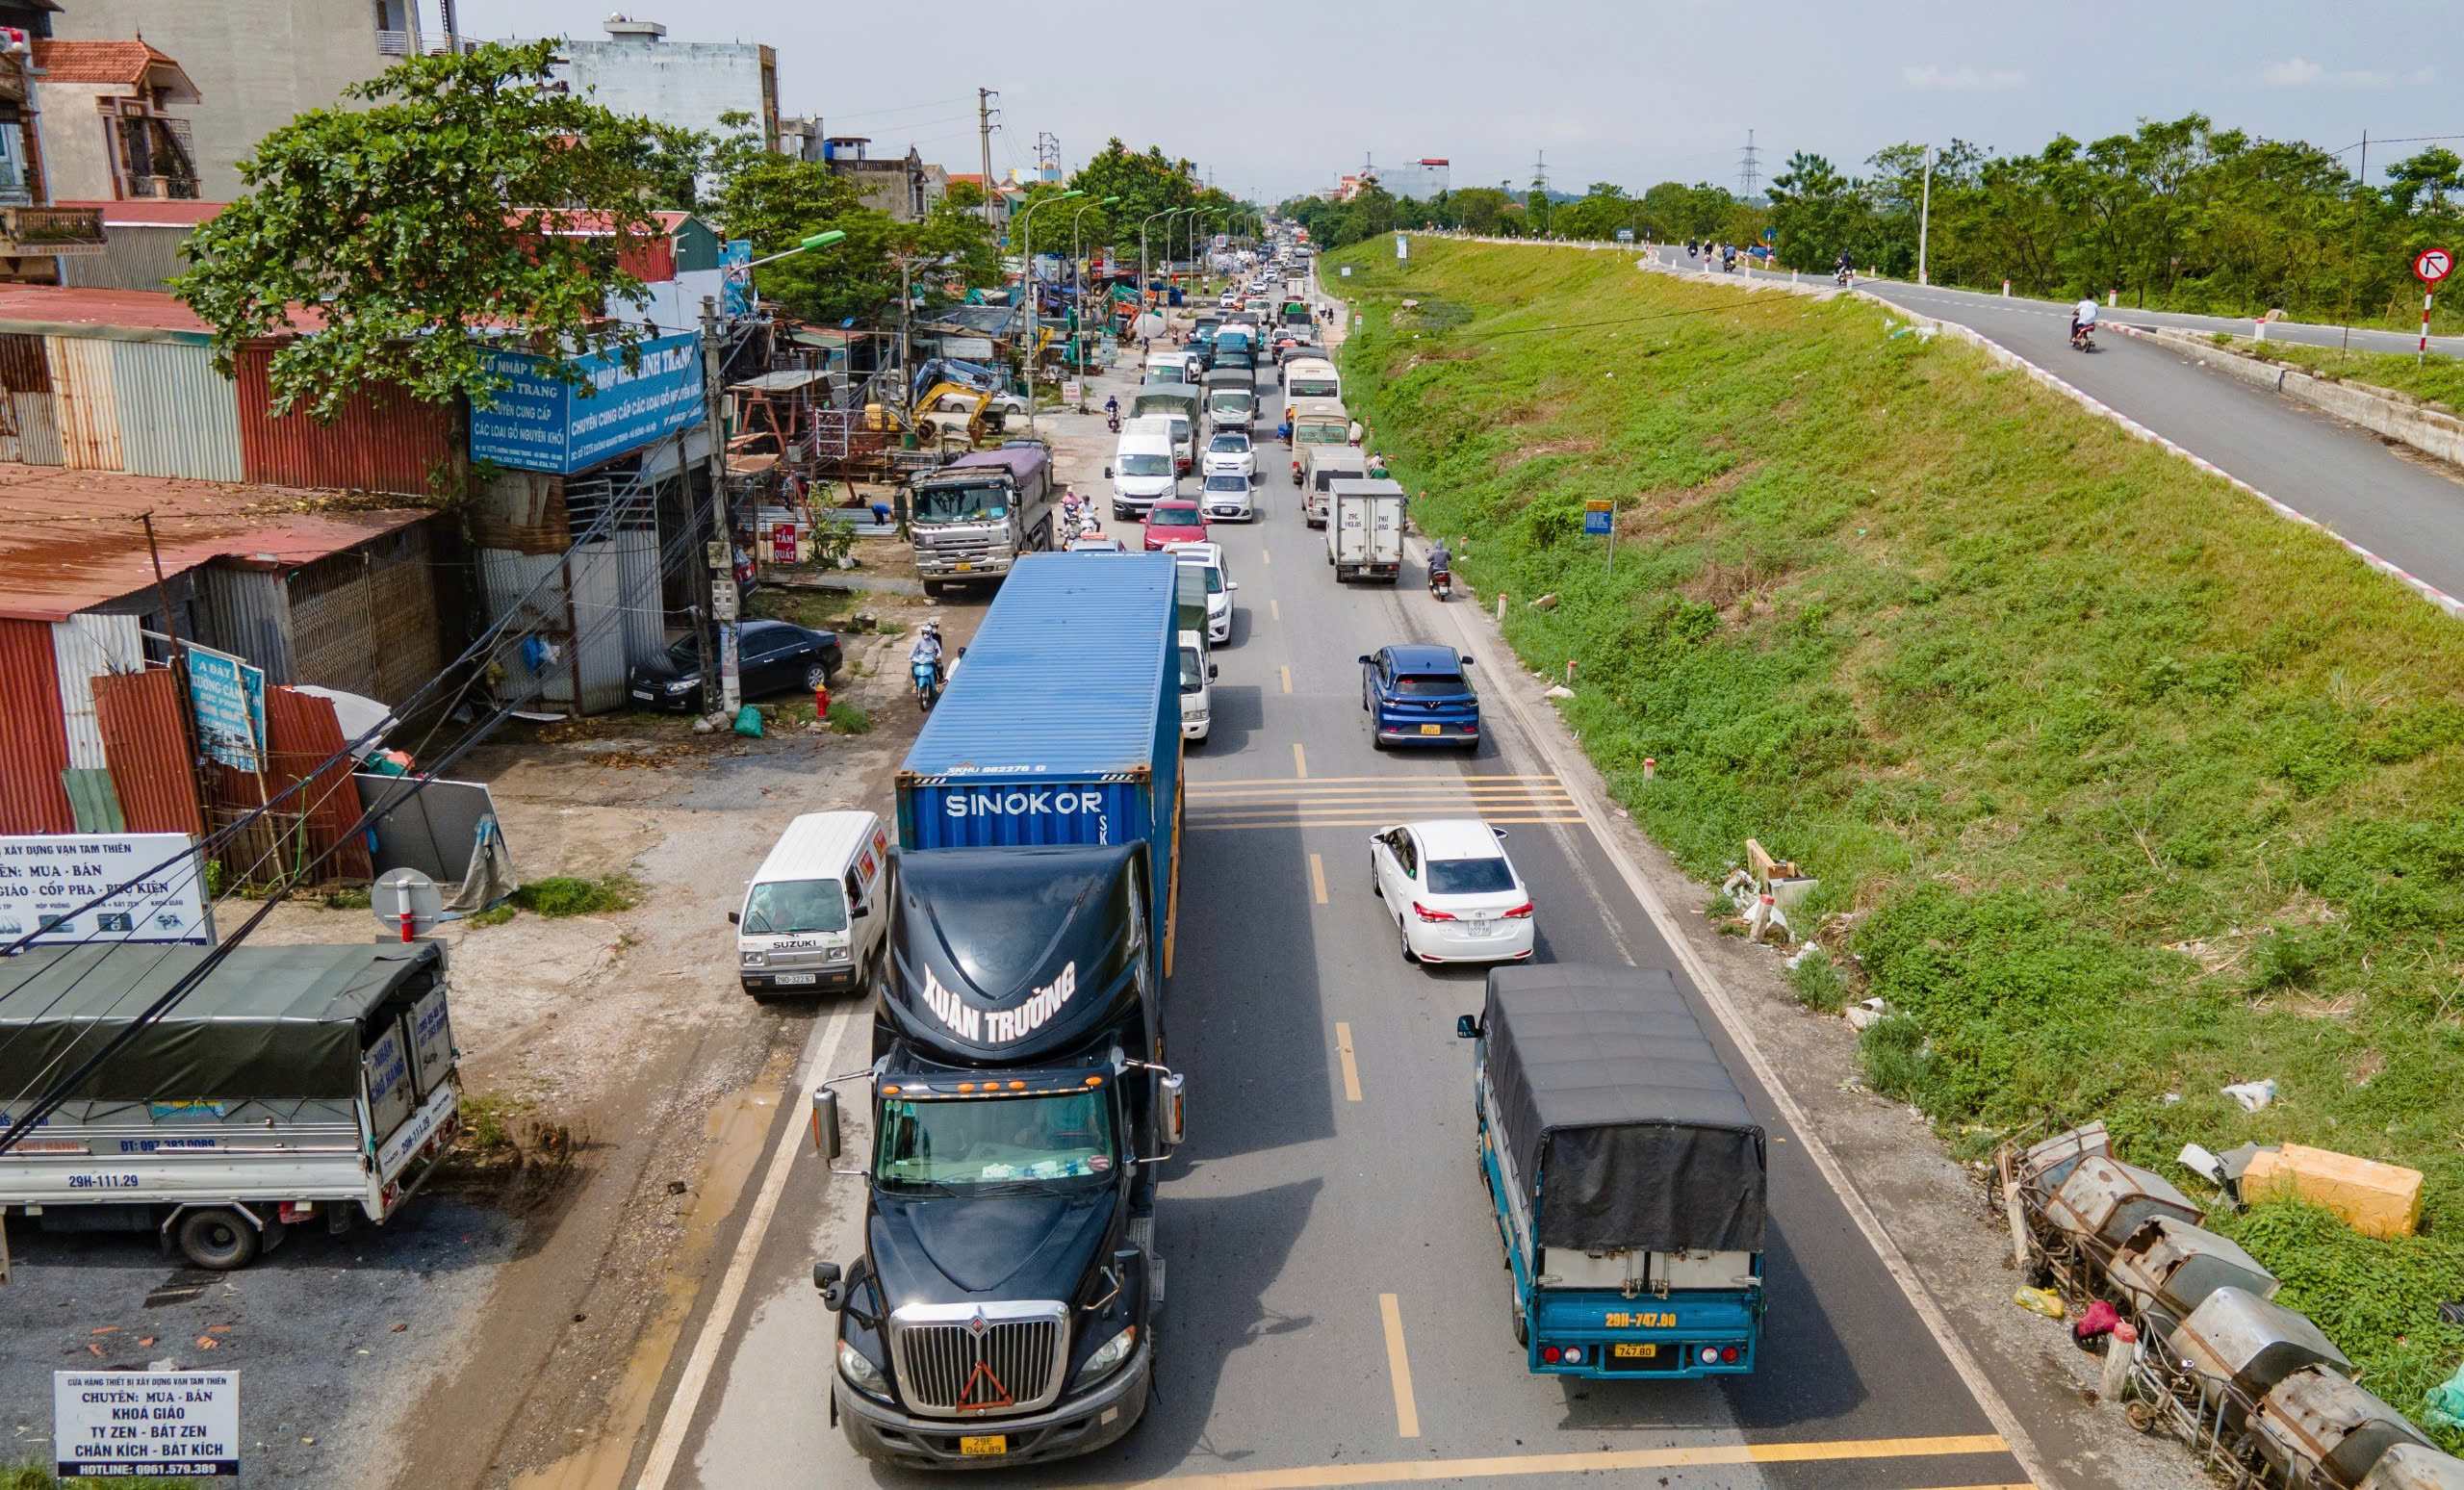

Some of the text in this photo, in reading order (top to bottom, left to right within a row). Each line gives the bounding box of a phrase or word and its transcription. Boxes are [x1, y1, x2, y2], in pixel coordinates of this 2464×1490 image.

[498, 360, 528, 376] NHẬP
[516, 382, 558, 398] TRANG
[516, 404, 536, 420] CUNG
[537, 403, 552, 421] CẤP
[571, 412, 598, 436] CHUYÊN
[599, 407, 617, 426] CUNG
[618, 398, 631, 420] CẤP
[631, 397, 646, 415] CÁC
[475, 420, 491, 436] CÁC
[520, 426, 547, 443] NGUYÊN
[945, 791, 1102, 817] SINOKOR
[4, 844, 23, 856] XÂY
[26, 844, 54, 858] DỰNG
[79, 844, 100, 854] TAM
[102, 842, 132, 854] THIÊN
[30, 865, 62, 877] MUA
[72, 861, 102, 877] BÁN
[39, 880, 64, 896] CỐP
[68, 885, 96, 895] PHA
[773, 939, 816, 949] SUZUKI
[922, 961, 1076, 1043] XUÂN TRƯỜNG
[69, 1174, 139, 1188] 29H-111.29
[82, 1389, 213, 1403] CHUYÊN: MUA BÁN
[113, 1404, 185, 1420] KHOÁ GIÁO
[90, 1423, 207, 1438] TY ZEN BÁT ZEN
[75, 1441, 223, 1457] CHÂN KÍCH BÁT KÍCH
[79, 1465, 134, 1475] HOTLINE:
